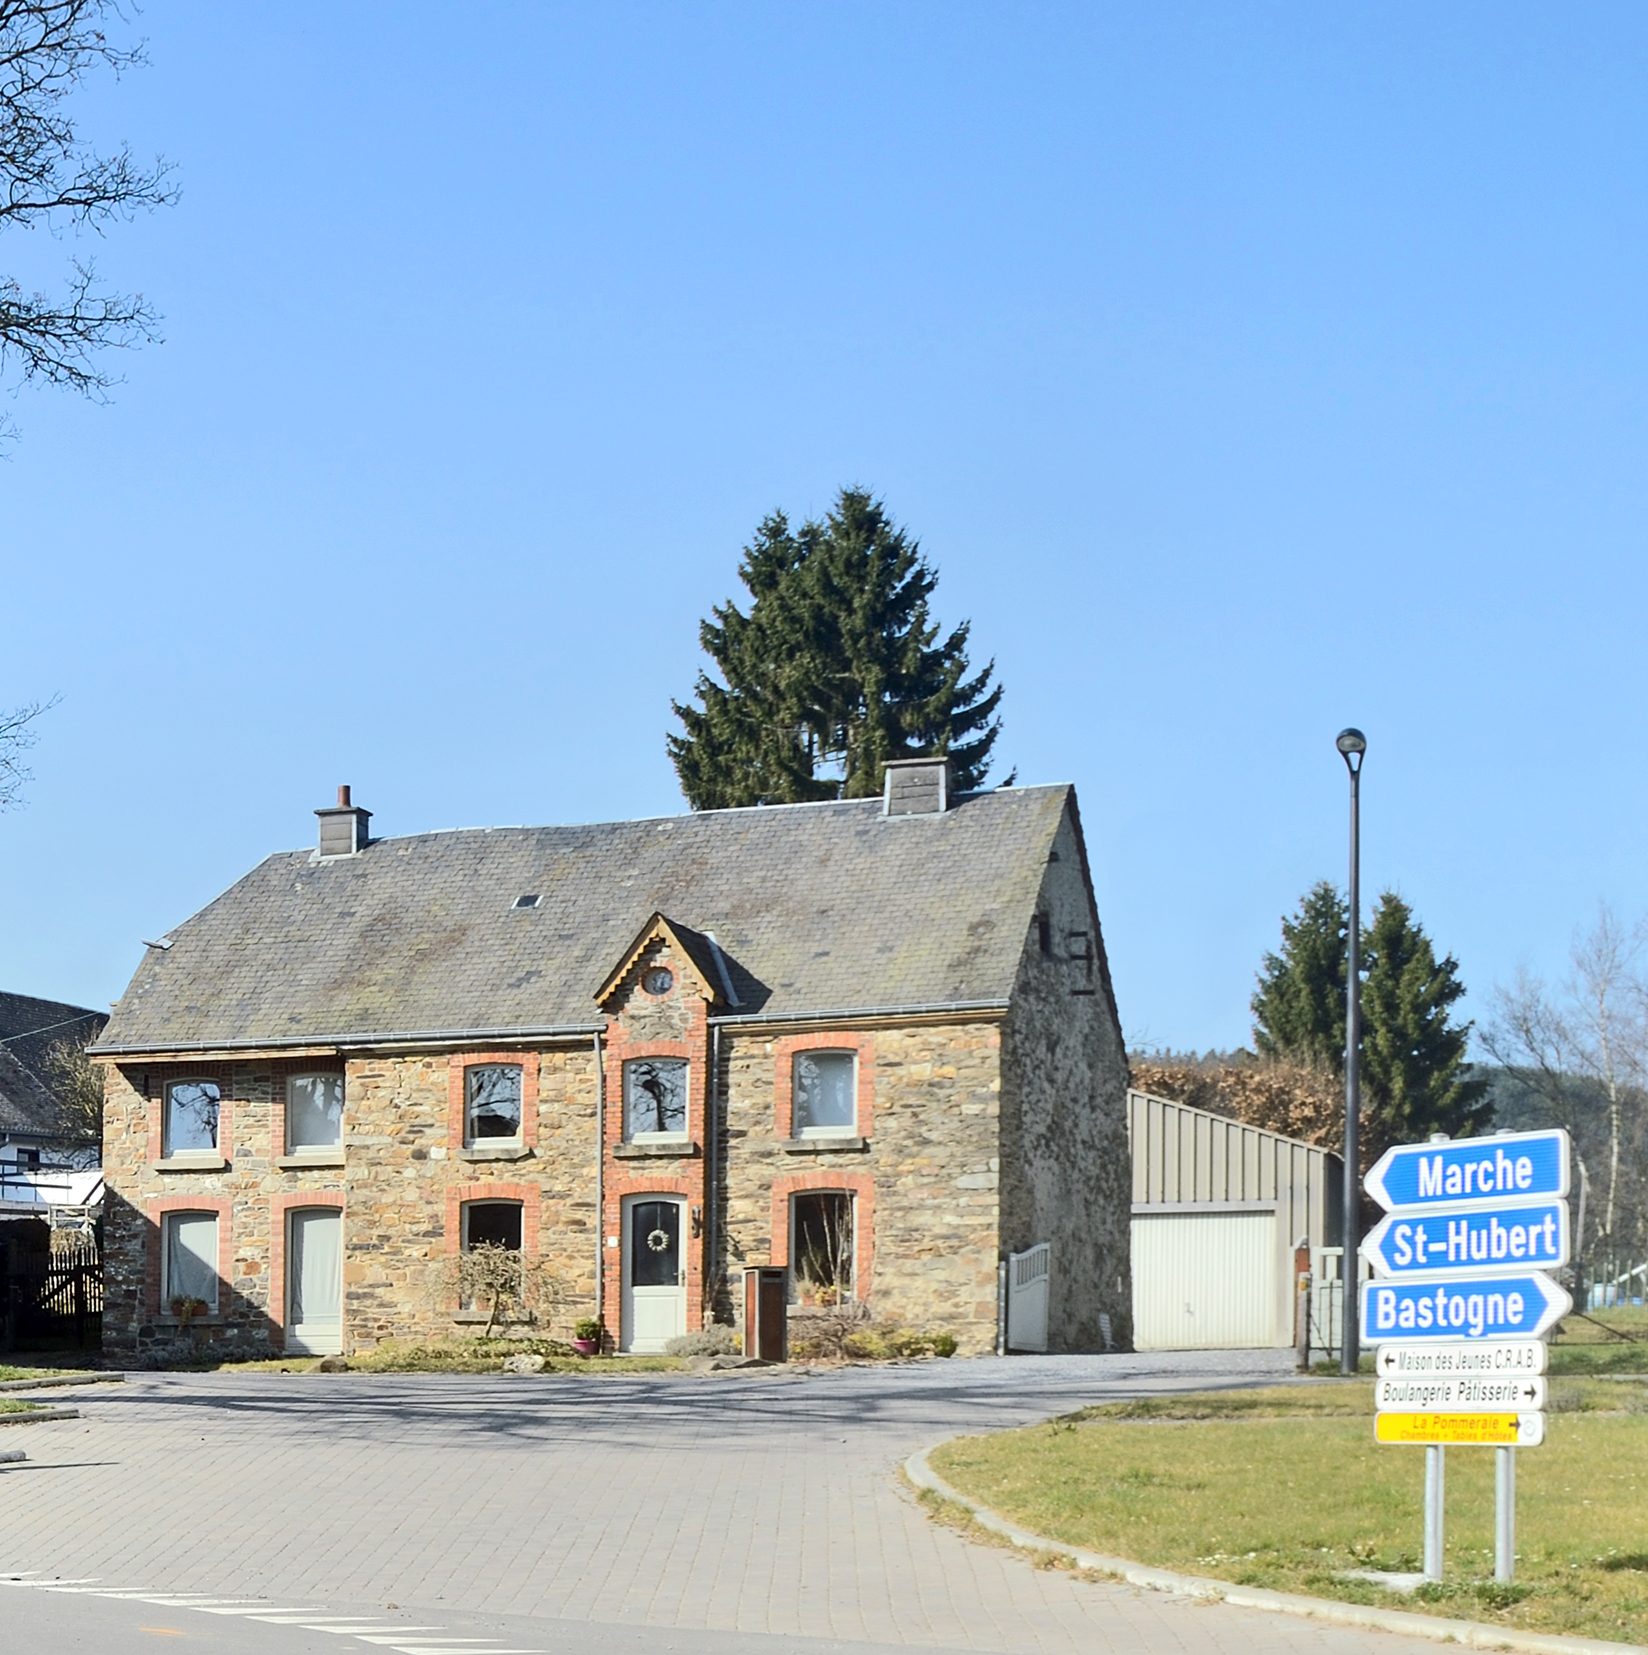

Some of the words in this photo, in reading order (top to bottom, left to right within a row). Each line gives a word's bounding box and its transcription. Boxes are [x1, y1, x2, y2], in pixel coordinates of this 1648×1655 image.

[1418, 1149, 1533, 1197] Marche
[1393, 1213, 1557, 1266] St-Hubert
[1377, 1287, 1524, 1336] Bastogne
[1398, 1352, 1433, 1370] Maison
[1435, 1350, 1453, 1369] des
[1455, 1350, 1492, 1370] Jeunes
[1495, 1348, 1537, 1369] C.R.A.B.
[1383, 1383, 1451, 1407] Boulangerie
[1457, 1379, 1519, 1401] Pâtisserie
[1400, 1430, 1440, 1440] Chambres
[1413, 1416, 1427, 1429] La
[1433, 1415, 1499, 1430] Pommeraie
